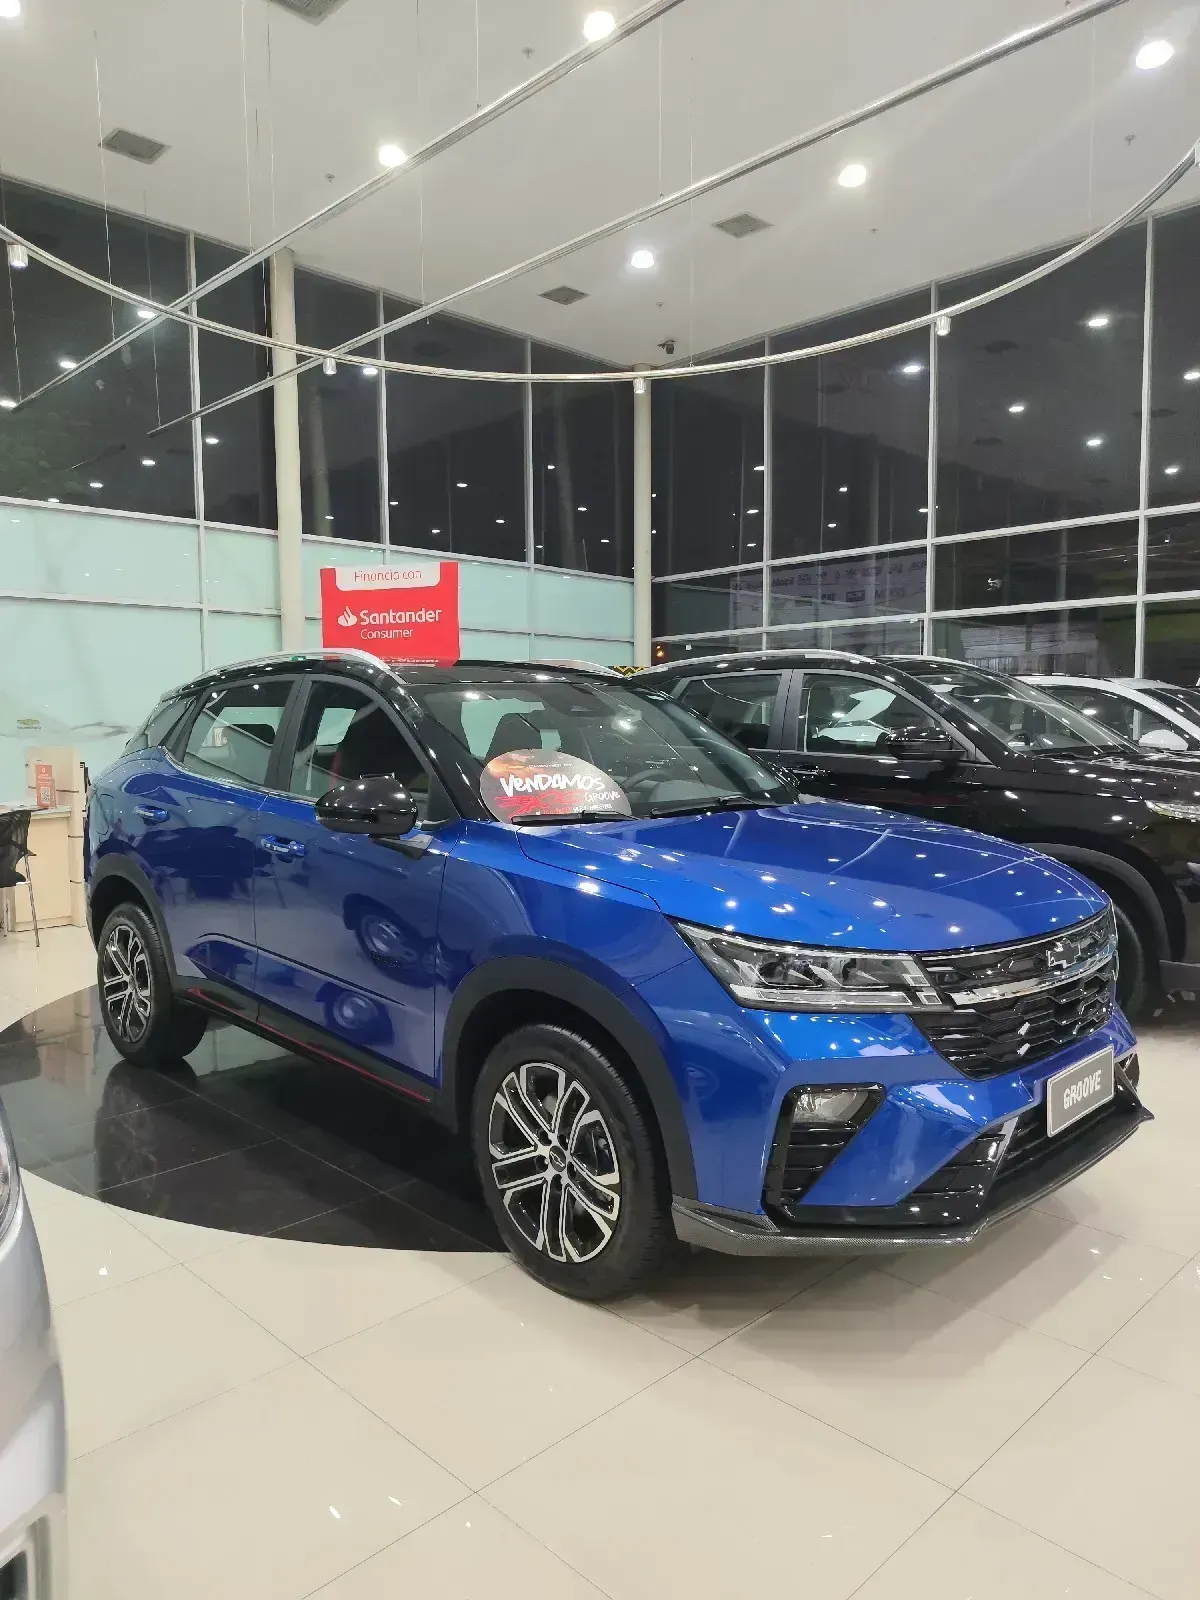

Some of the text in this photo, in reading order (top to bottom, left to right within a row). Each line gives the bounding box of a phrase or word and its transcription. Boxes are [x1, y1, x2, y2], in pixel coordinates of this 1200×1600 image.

[354, 569, 422, 582] Financia con
[360, 608, 442, 625] Santander
[360, 628, 414, 640] Consumer
[1063, 1069, 1102, 1110] GROOVE
